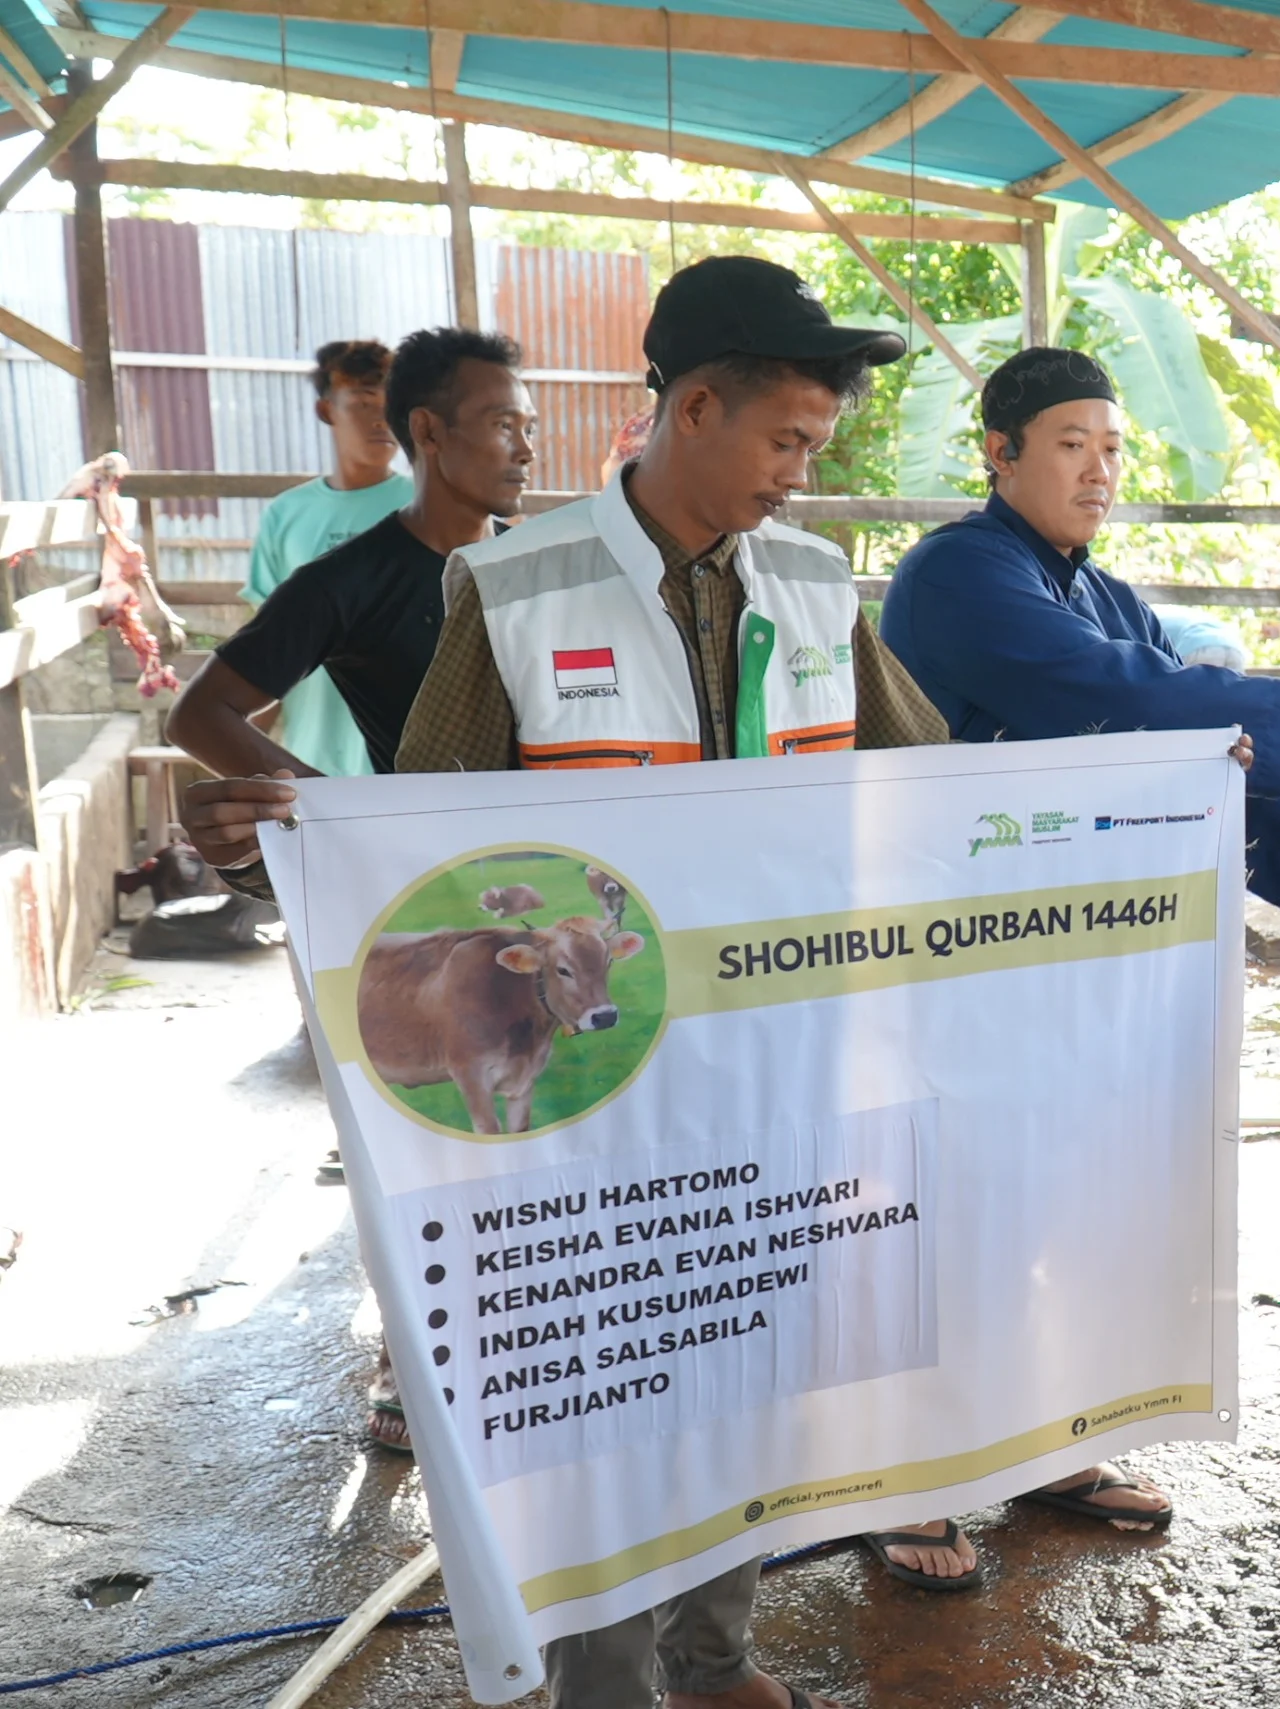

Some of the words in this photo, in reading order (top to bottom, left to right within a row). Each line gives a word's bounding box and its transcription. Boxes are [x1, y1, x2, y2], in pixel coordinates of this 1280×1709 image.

[558, 687, 620, 700] INDONESIA
[1113, 819, 1125, 827] PT
[717, 925, 914, 980] SHOHIBUL
[925, 904, 1072, 957] QURBAN
[1082, 893, 1178, 931] 1446H
[472, 1191, 587, 1236] WISNU
[599, 1162, 760, 1210] HARTOMO
[476, 1229, 603, 1277] KEISHA
[615, 1205, 735, 1247] EVANIA
[745, 1177, 861, 1222] ISHVARI
[477, 1256, 665, 1318] KENANDRA
[676, 1237, 758, 1274] EVAN
[768, 1201, 920, 1255] NESHVARA
[479, 1314, 586, 1359] INDAH
[598, 1262, 809, 1332] KUSUMADEWI
[480, 1354, 587, 1400] ANISA
[596, 1309, 768, 1370] SALSABILA
[483, 1371, 671, 1441] FURJIANTO
[1143, 1397, 1169, 1410] Ymm
[769, 1479, 883, 1511] official.ymmcarefi
